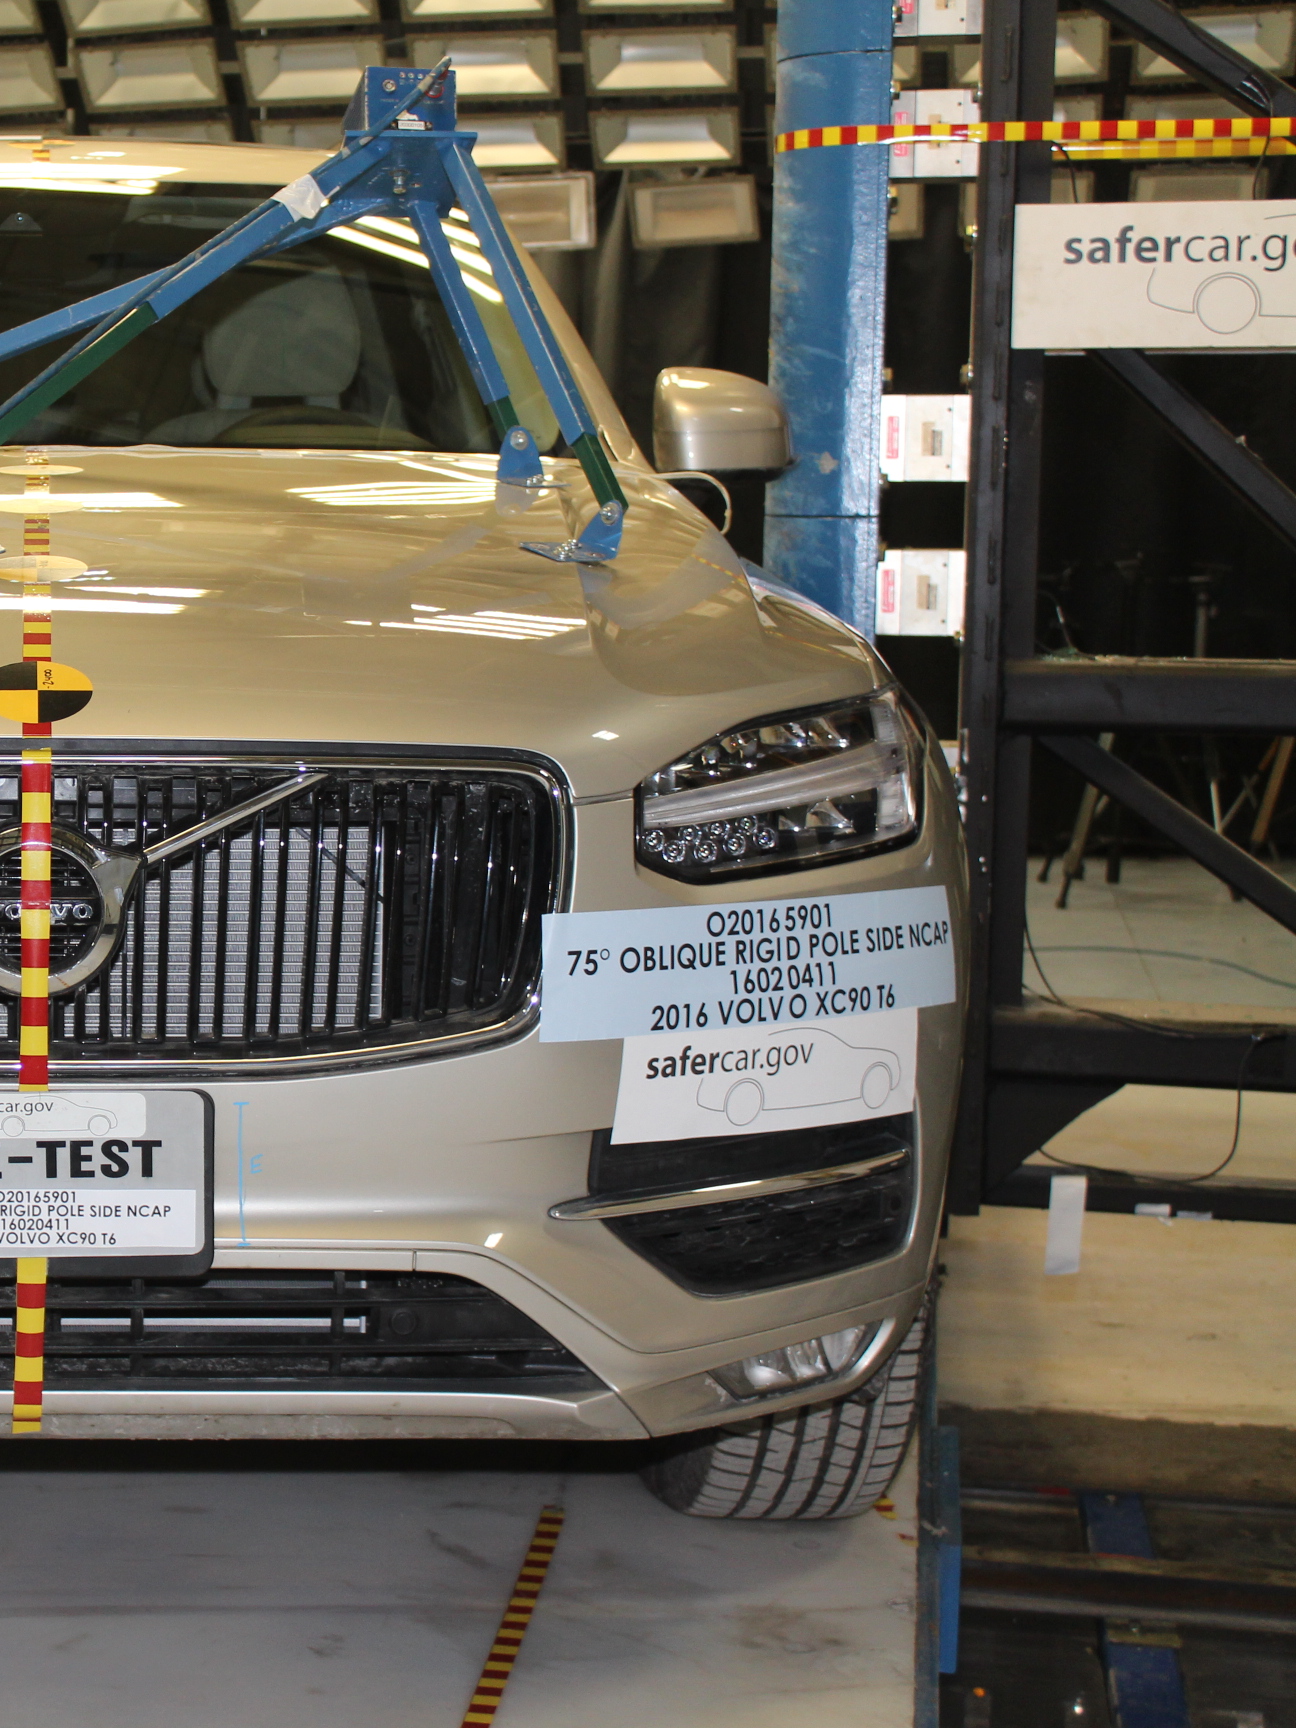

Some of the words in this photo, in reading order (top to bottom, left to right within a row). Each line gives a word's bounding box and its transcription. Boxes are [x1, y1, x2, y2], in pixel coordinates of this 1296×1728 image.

[1063, 225, 1296, 272] safercar.g
[566, 948, 611, 976] 75°
[619, 941, 727, 974] OBLIQUE
[735, 935, 801, 966] RIGID
[809, 929, 861, 959] POLE
[866, 924, 905, 953] SIDE
[909, 920, 950, 949] NCAP
[729, 961, 837, 995] 16020411
[650, 1002, 709, 1032] 2016
[718, 993, 808, 1026] VOLVO
[815, 987, 871, 1017] XC90
[876, 984, 896, 1009] T6
[645, 1043, 814, 1080] safercar.gov
[0, 1204, 43, 1218] RIGID
[47, 1204, 85, 1218] POLE
[89, 1204, 123, 1218] SIDE
[127, 1204, 171, 1218] NCAP
[0, 1218, 70, 1231] 16020411
[56, 1232, 97, 1245] XC90
[101, 1232, 117, 1246] T6
